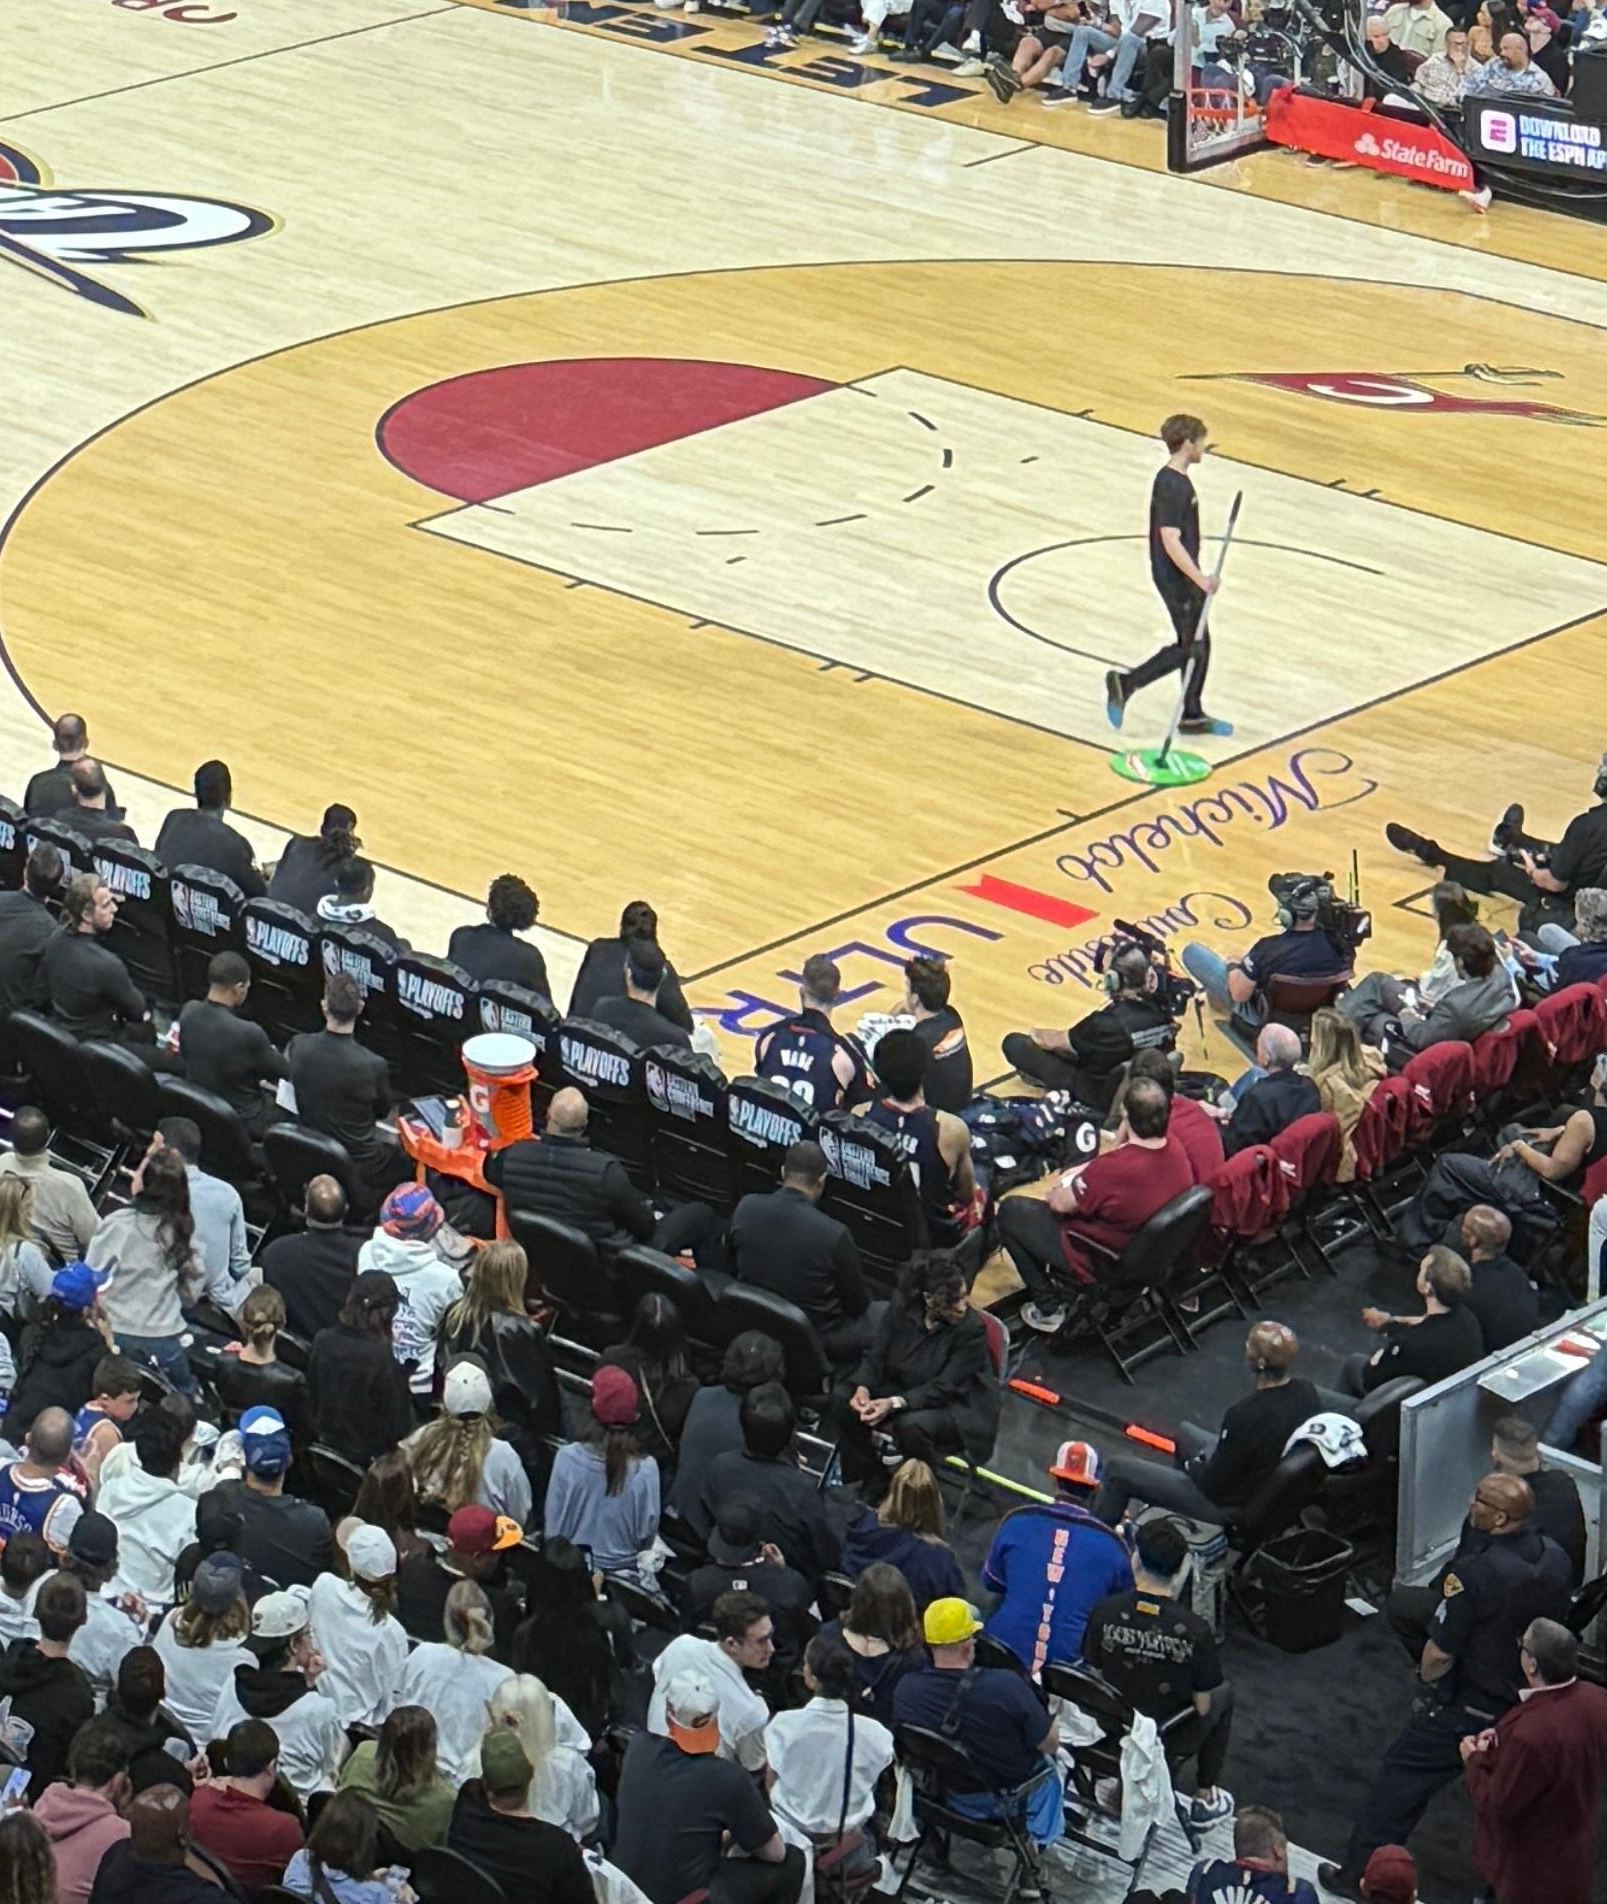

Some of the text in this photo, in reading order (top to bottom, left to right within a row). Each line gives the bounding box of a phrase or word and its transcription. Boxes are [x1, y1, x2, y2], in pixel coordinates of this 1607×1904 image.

[692, 44, 981, 110] LET
[1519, 113, 1602, 151] DOWNLOAD
[1520, 136, 1585, 167] THE ESPN
[1056, 747, 1379, 893] Michelob
[256, 921, 311, 966] PLAYOFFS
[407, 973, 466, 1021] PLAYOFFS
[571, 1042, 632, 1087] PLAYOFFS
[780, 1049, 815, 1073] WADE
[740, 1102, 803, 1146] PLAYOFFS
